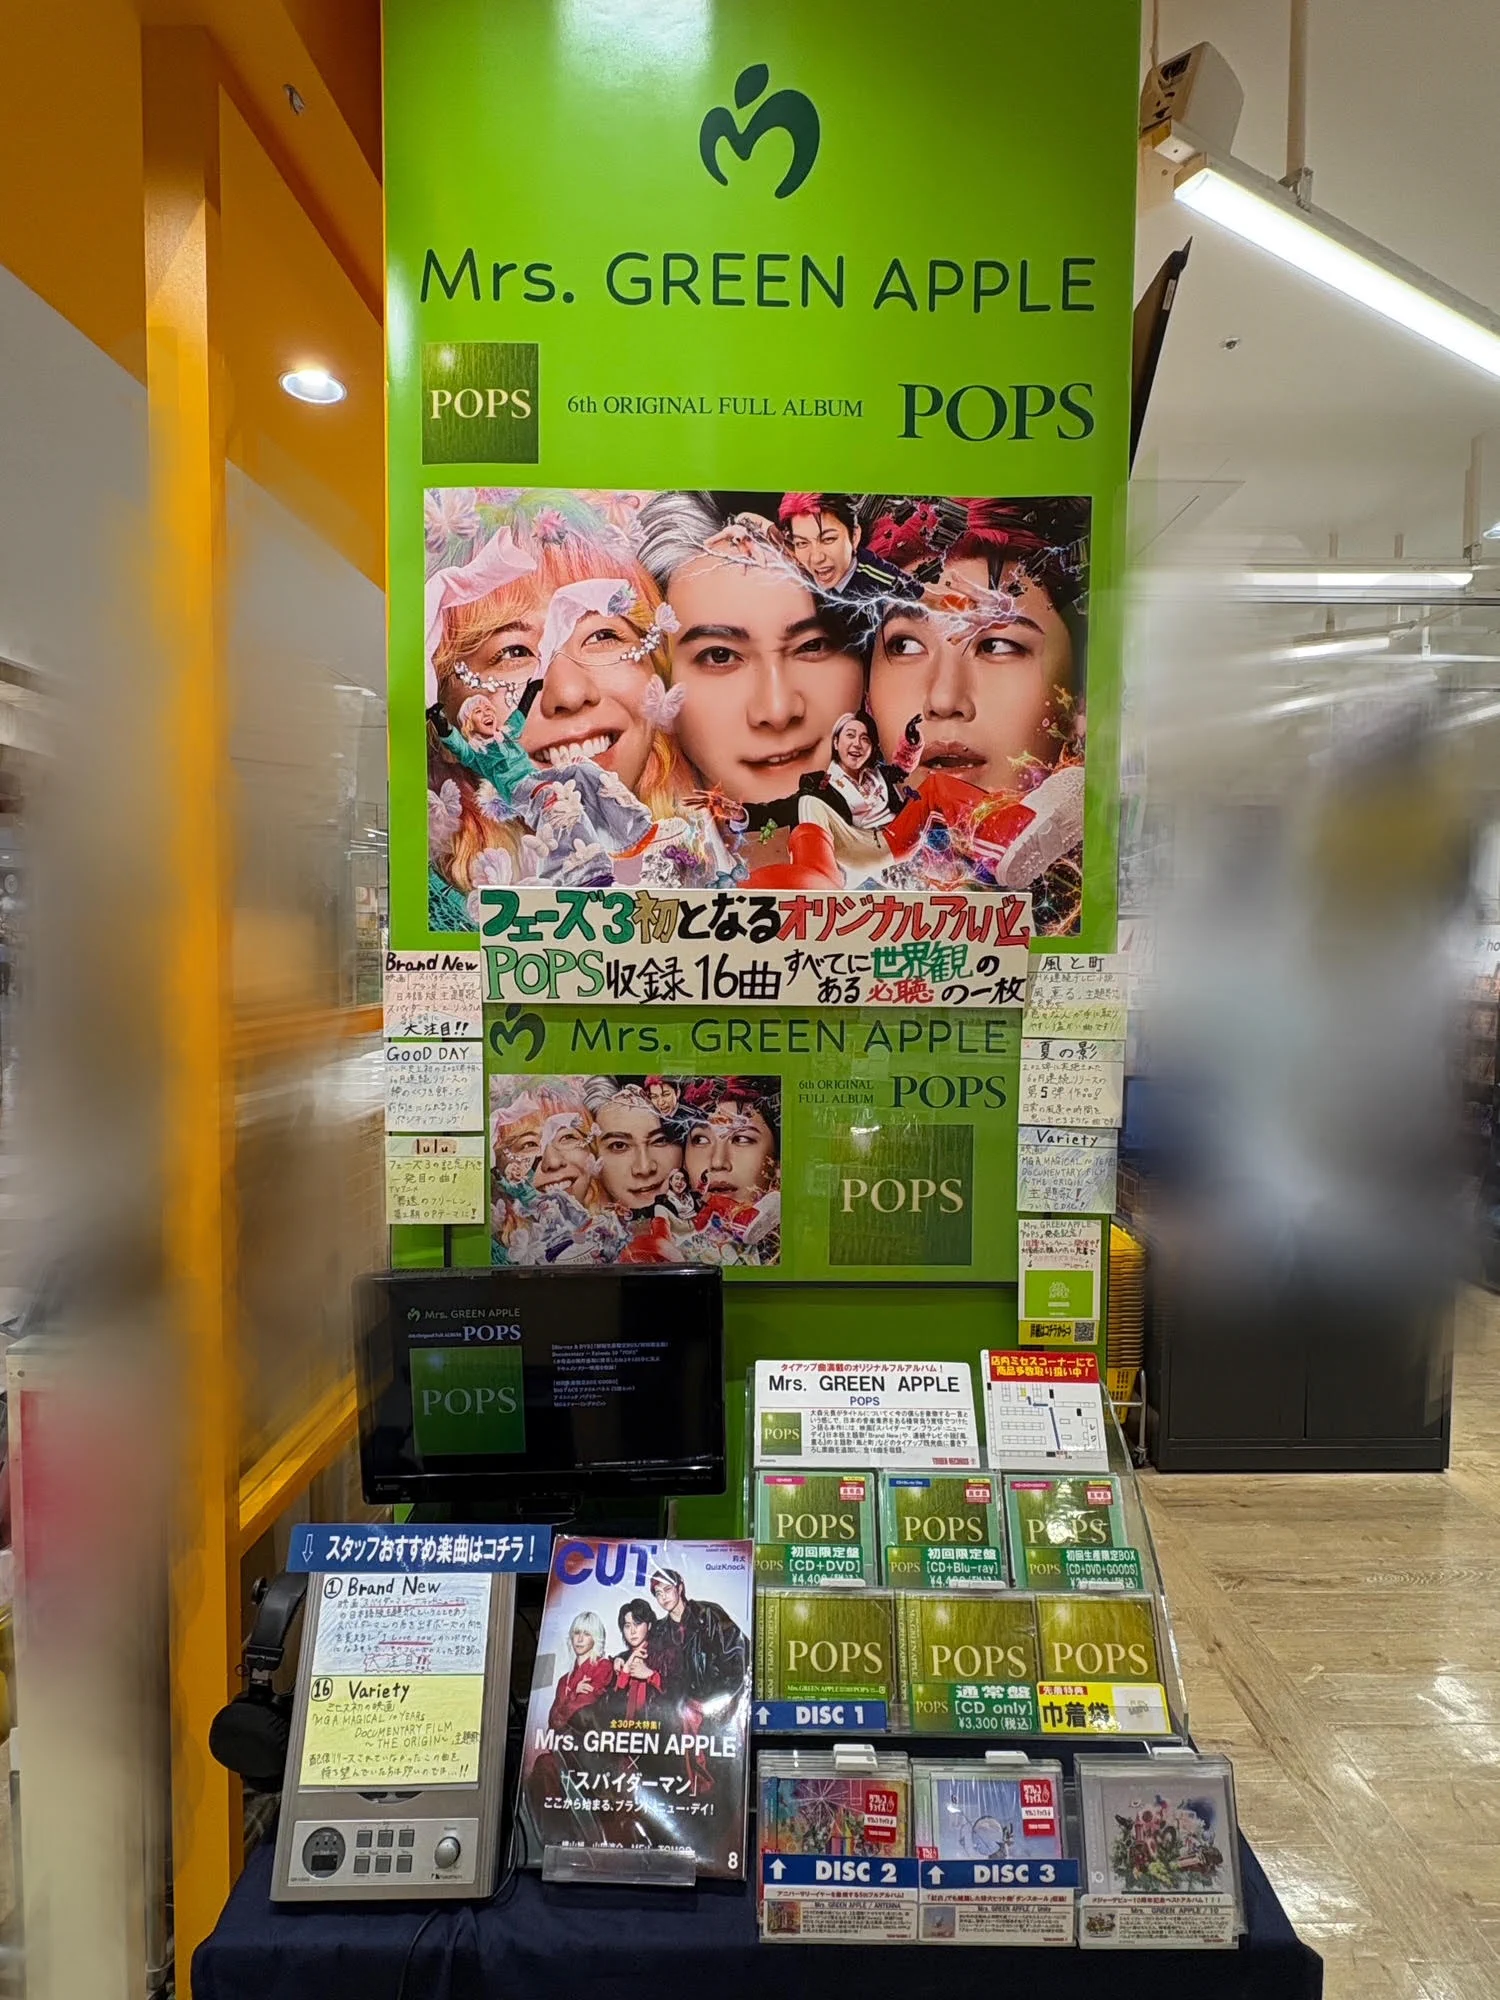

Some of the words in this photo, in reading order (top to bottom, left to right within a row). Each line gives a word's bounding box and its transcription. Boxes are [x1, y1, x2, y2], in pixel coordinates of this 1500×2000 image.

[419, 247, 575, 305] Mrs.
[605, 252, 845, 308] GREEN
[873, 257, 1096, 313] APPLE
[430, 389, 531, 420] POPS
[567, 396, 598, 415] 6th
[603, 396, 713, 416] ORIGINAL
[718, 397, 778, 417] FULL
[782, 399, 865, 418] ALBUM
[897, 383, 1095, 443] POPS
[386, 952, 439, 971] Brand
[441, 955, 478, 971] New
[1042, 956, 1105, 972] 風と町
[571, 1018, 672, 1052] Mrs.
[691, 1018, 845, 1053] GREEN
[863, 1019, 1007, 1053] APPLE
[439, 1046, 469, 1060] DAY
[1039, 1040, 1098, 1060] 夏の影
[798, 1079, 814, 1090] 6th
[817, 1079, 874, 1090] ORIGINAL
[890, 1075, 1007, 1109] POPS
[799, 1093, 828, 1104] FULL
[831, 1093, 874, 1104] ALBUM
[1037, 1129, 1098, 1147] Variety
[840, 1178, 964, 1214] POPS
[425, 1311, 447, 1319] Mrs.
[451, 1309, 485, 1319] GREEN
[488, 1308, 521, 1318] APPLE
[463, 1325, 521, 1341] POPS
[991, 1356, 1095, 1367] 店内ミセスコーナーにて
[996, 1366, 1089, 1377] 商品多数取り扱い中!
[769, 1375, 806, 1392] Mrs.
[819, 1376, 885, 1392] GREEN
[898, 1376, 960, 1392] APPLE
[421, 1386, 517, 1416] POPS
[850, 1396, 880, 1406] POPS
[764, 1428, 800, 1441] POPS
[776, 1513, 855, 1539] POPS
[904, 1517, 983, 1542] POPS
[1026, 1518, 1108, 1544] PPS
[325, 1535, 536, 1563] スタッフおすすめ楽曲はコチラ!
[791, 1546, 860, 1558] 初回限定盤
[927, 1547, 997, 1560] 初回限定盤
[1066, 1549, 1136, 1561] 初回生産限定BOX
[556, 1542, 657, 1587] CUT
[705, 1563, 746, 1571] QuizKnock
[789, 1559, 860, 1572] [CD+DVD]
[891, 1562, 920, 1573] POPS
[926, 1561, 998, 1575] [CD+Blu-ray]
[1029, 1563, 1061, 1575] POPS
[347, 1577, 395, 1596] Brand
[402, 1576, 442, 1595] New
[786, 1640, 883, 1674] POPS
[930, 1645, 1027, 1678] POPS
[1051, 1642, 1149, 1675] POPS
[349, 1680, 410, 1703] Variety
[955, 1685, 1031, 1699] 通常盤
[796, 1706, 844, 1724] DISC
[854, 1706, 864, 1724] 1
[916, 1700, 948, 1713] POPS
[993, 1701, 1033, 1715] only]
[343, 1713, 385, 1726] MAGICAL
[425, 1722, 453, 1733] FILM
[610, 1719, 661, 1730] 全30P大特集!
[958, 1717, 998, 1729] ¥3,300
[1001, 1717, 1032, 1730] (税込)
[378, 1738, 399, 1749] THE
[535, 1728, 579, 1751] Mrs.
[583, 1730, 660, 1754] GREEN
[664, 1734, 737, 1758] APPLE
[567, 1768, 698, 1797] 「スパイダーマン」
[543, 1797, 715, 1816] ここから始まる、ブランドニュー・デイ!
[727, 1852, 738, 1869] 8
[815, 1860, 871, 1882] DISC
[880, 1862, 897, 1883] 2
[973, 1864, 1029, 1883] DISC
[1039, 1864, 1056, 1883] 3
